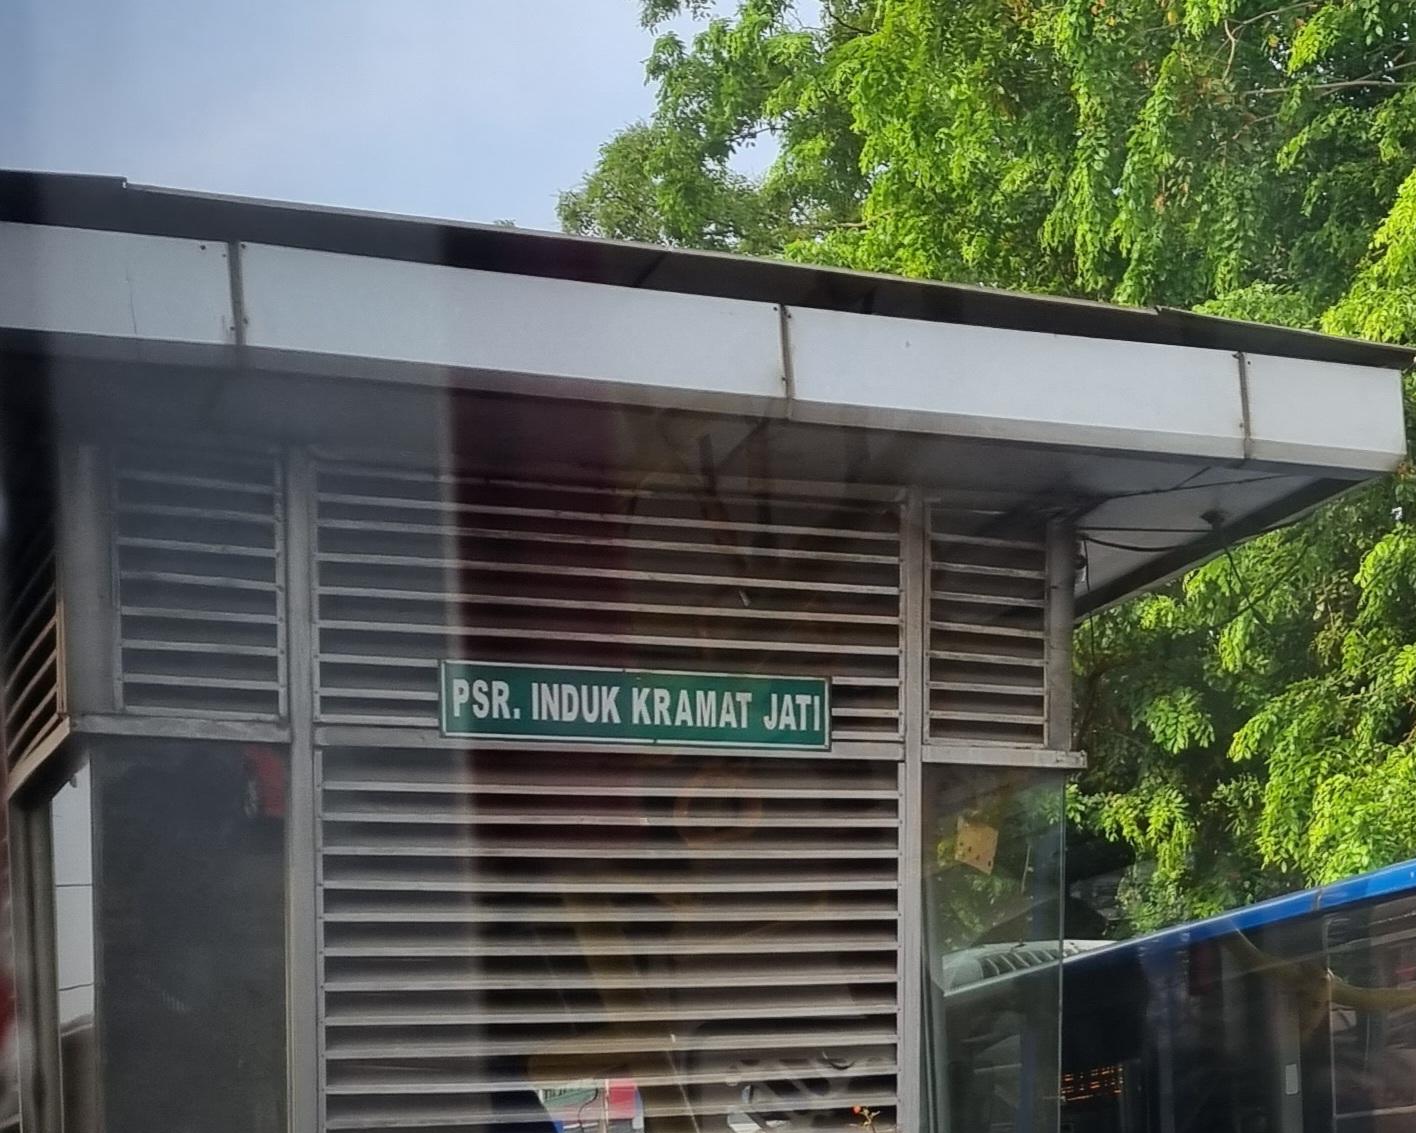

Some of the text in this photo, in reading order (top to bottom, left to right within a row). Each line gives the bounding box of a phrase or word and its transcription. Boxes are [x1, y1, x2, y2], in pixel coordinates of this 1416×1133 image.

[451, 678, 821, 731] PSR. INDUK KRAMAT JATI
